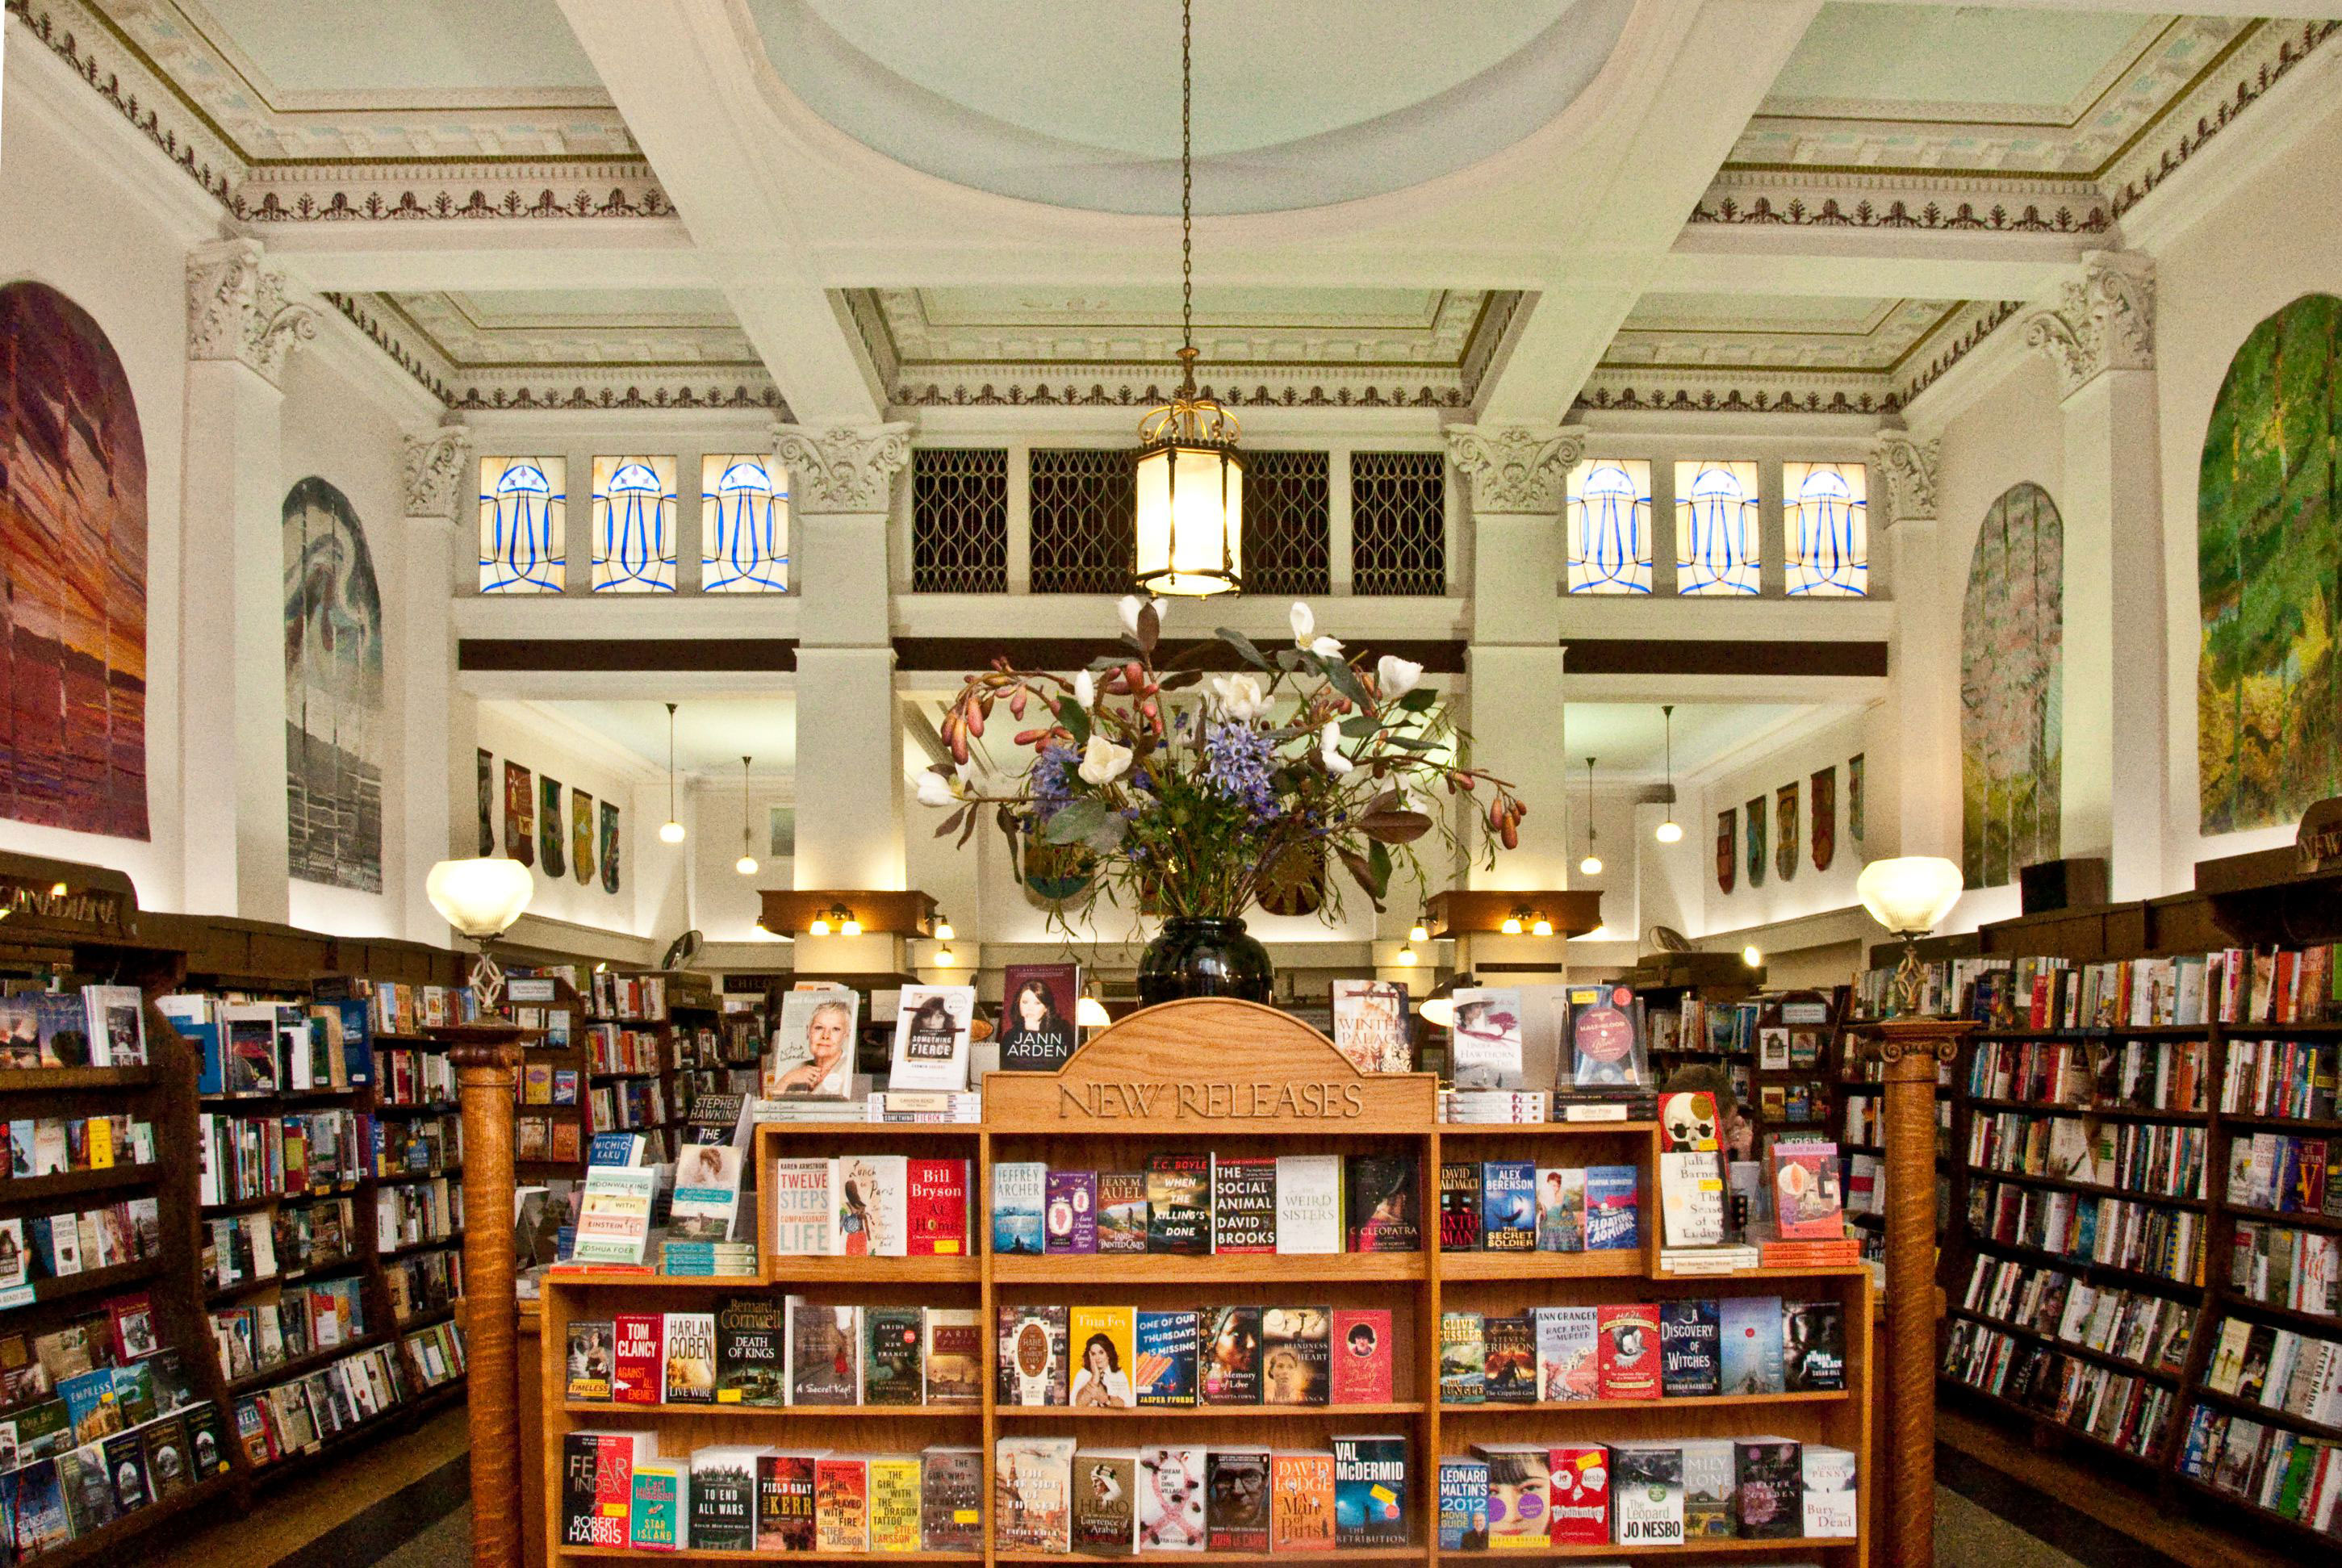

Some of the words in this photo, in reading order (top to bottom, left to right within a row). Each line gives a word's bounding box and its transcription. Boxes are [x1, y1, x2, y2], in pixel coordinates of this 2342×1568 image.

[1339, 1018, 1405, 1031] WINTER
[912, 1035, 951, 1043] SOMETHING
[1014, 1032, 1062, 1045] JANN
[911, 1044, 951, 1056] FIERCE
[1007, 1045, 1067, 1057] ARDEN
[695, 1098, 741, 1109] STEPHEN
[1058, 1083, 1164, 1119] NEW
[1176, 1083, 1363, 1118] RELEASES
[689, 1109, 739, 1120] HAWKING
[701, 1128, 719, 1139] THE
[597, 1151, 620, 1160] KAKU
[923, 1169, 949, 1183] Bill
[997, 1170, 1039, 1183] JEFFREY
[1216, 1166, 1241, 1179] THE
[1442, 1169, 1470, 1178] DAVID
[1499, 1170, 1520, 1180] ALEX
[589, 1181, 649, 1190] MOONWALKING
[781, 1173, 827, 1189] TWELVE
[1101, 1177, 1127, 1187] JEAN
[1131, 1177, 1144, 1187] M.
[1165, 1178, 1196, 1187] WHEN
[1487, 1180, 1533, 1190] BERENSON
[911, 1184, 962, 1200] Bryson
[997, 1184, 1039, 1196] ARCHER
[1102, 1187, 1143, 1198] AUEL
[1216, 1182, 1267, 1194] SOCIAL
[780, 1191, 827, 1210] STEPS
[1170, 1194, 1190, 1203] THE
[1217, 1198, 1272, 1210] ANIMAL
[1285, 1195, 1332, 1206] WEIRD
[780, 1215, 827, 1223] COMPASSIONATE
[1155, 1210, 1204, 1220] KILLING'S
[1282, 1210, 1334, 1221] SISTERS
[588, 1221, 623, 1229] EINSTEIN
[1217, 1216, 1260, 1228] DAVID
[1588, 1214, 1634, 1233] FLOATING
[1166, 1227, 1195, 1236] DONE
[1361, 1226, 1417, 1236] CLEOPATRA
[1488, 1231, 1533, 1240] SECRET
[1592, 1223, 1635, 1244] ADMIRAL
[780, 1224, 828, 1251] LIFE
[1218, 1231, 1274, 1244] BROOKS
[728, 1298, 773, 1314] Bernard
[721, 1308, 781, 1330] Cornwell
[1538, 1312, 1555, 1321] ANN
[1558, 1312, 1597, 1321] GRANGER
[670, 1320, 712, 1336] HARLAN
[1140, 1320, 1158, 1330] ONE
[1161, 1318, 1173, 1327] OF
[1176, 1315, 1196, 1325] OUR
[1444, 1319, 1475, 1330] CLIVE
[627, 1323, 649, 1340] TOM
[1144, 1328, 1197, 1344] THURSDAYS
[1662, 1322, 1713, 1340] DISCOVERY
[735, 1337, 768, 1347] DEATH
[1690, 1341, 1700, 1353] OF
[617, 1341, 655, 1357] CLANCY
[670, 1337, 713, 1359] COBEN
[729, 1348, 742, 1358] OF
[746, 1348, 775, 1358] KINGS
[1158, 1342, 1196, 1354] MISSING
[1485, 1343, 1535, 1353] ERIKSON
[1667, 1351, 1710, 1370] WITCHES
[617, 1367, 646, 1378] AGAINST
[1223, 1371, 1256, 1381] Memory
[643, 1378, 653, 1388] ALL
[1220, 1381, 1228, 1389] of
[1230, 1381, 1248, 1389] Love
[571, 1385, 609, 1393] TIMELESS
[628, 1388, 655, 1401] ENEMIES
[797, 1385, 802, 1394] A
[805, 1385, 833, 1394] Secret
[834, 1384, 855, 1399] Kept
[1336, 1442, 1359, 1461] VAL
[570, 1455, 628, 1480] FEAR
[955, 1460, 968, 1468] THE
[1279, 1461, 1329, 1477] DAVID
[821, 1471, 835, 1480] THE
[889, 1471, 903, 1480] THE
[1336, 1461, 1403, 1481] McDERMID
[1441, 1470, 1487, 1483] LEONARD
[574, 1477, 621, 1495] INDEX
[829, 1481, 847, 1490] GIRL
[877, 1481, 896, 1489] GIRL
[1275, 1477, 1332, 1492] LODGE
[1441, 1484, 1487, 1496] MALTIN'S
[705, 1489, 716, 1501] TO
[719, 1490, 738, 1500] END
[818, 1489, 837, 1498] WHO
[890, 1489, 911, 1498] WITH
[770, 1496, 812, 1516] KERR
[832, 1499, 861, 1508] PLAYED
[877, 1498, 893, 1507] THE
[1080, 1499, 1129, 1514] HERO
[1282, 1497, 1321, 1515] Man
[1441, 1499, 1487, 1512] 2012
[699, 1503, 714, 1515] ALL
[718, 1503, 744, 1516] WARS
[823, 1507, 844, 1516] WITH
[884, 1507, 918, 1516] DRAGON
[1626, 1506, 1670, 1522] Leopard
[1808, 1503, 1835, 1516] Bury
[873, 1516, 902, 1525] TATTOO
[1081, 1516, 1119, 1526] Lawrence
[1120, 1518, 1129, 1526] of
[1441, 1511, 1468, 1520] MOVIE
[573, 1516, 619, 1528] ROBERT
[644, 1519, 666, 1529] STAR
[839, 1517, 857, 1527] FIRE
[1441, 1520, 1468, 1528] GUIDE
[1818, 1517, 1851, 1528] Dead
[894, 1525, 918, 1534] STIEG
[1091, 1526, 1118, 1534] Arabia
[1624, 1522, 1639, 1538] JO
[1642, 1520, 1680, 1537] NESBO
[569, 1528, 621, 1545] HARRIS
[637, 1529, 671, 1541] ISLAND
[827, 1536, 864, 1545] LARSSON
[873, 1534, 910, 1543] LARSSON
[1336, 1534, 1406, 1544] RETRIBUTION
